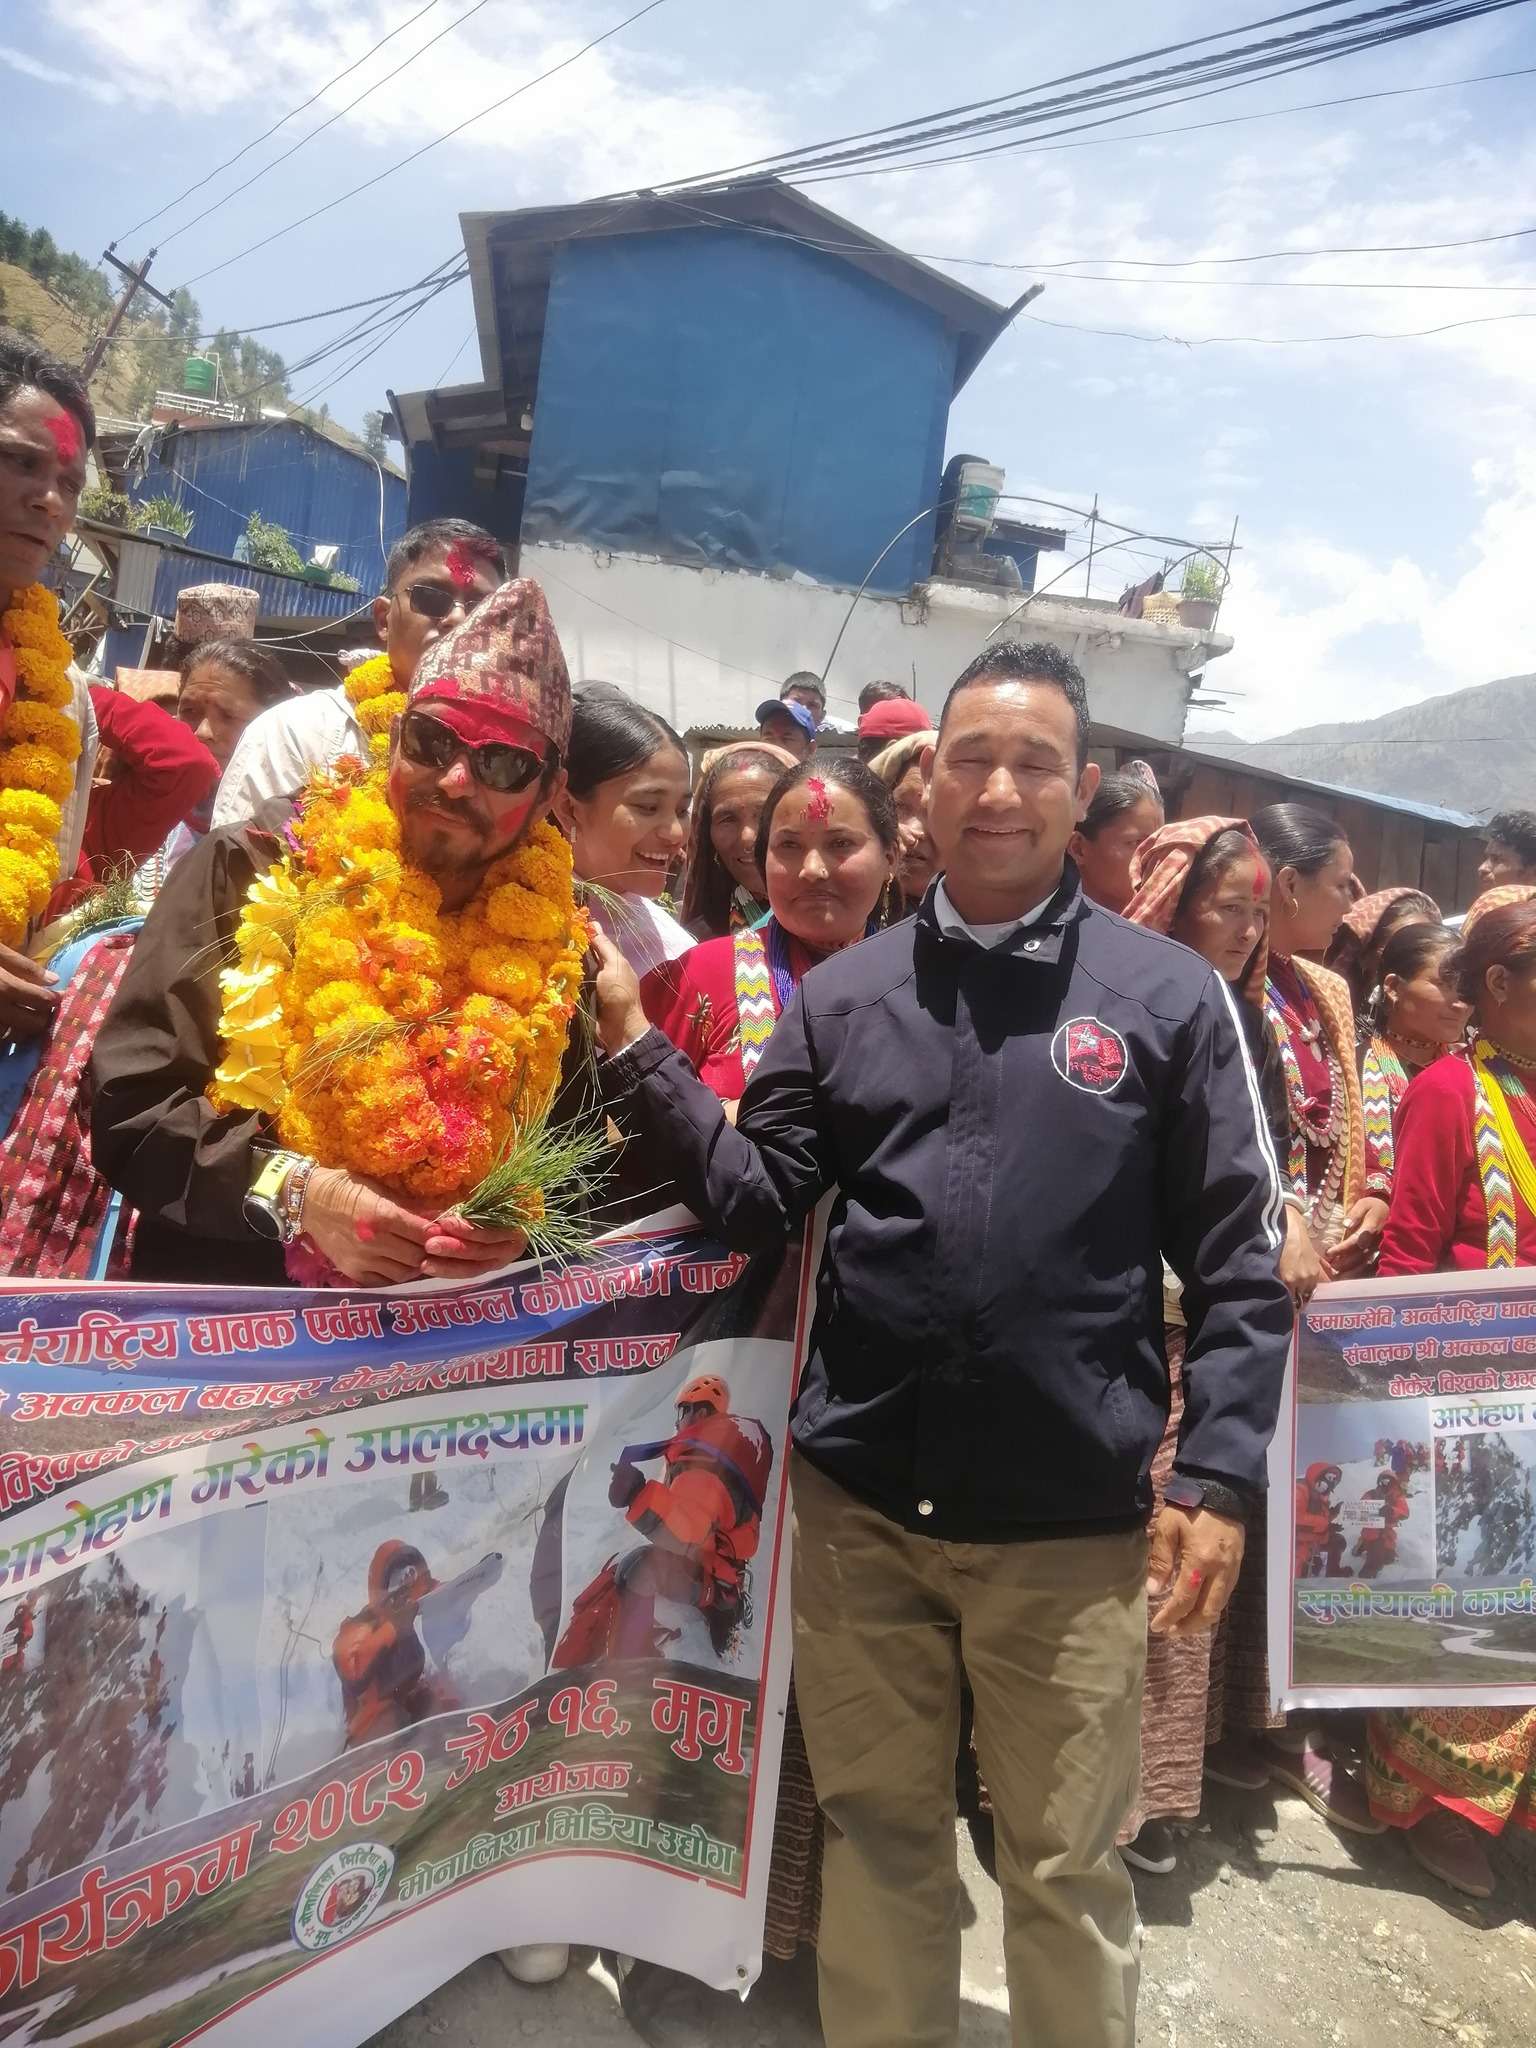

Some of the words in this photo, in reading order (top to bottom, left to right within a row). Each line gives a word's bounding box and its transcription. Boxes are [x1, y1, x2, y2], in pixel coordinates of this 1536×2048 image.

[188, 1310, 297, 1358] धावक
[387, 1287, 518, 1336] अक्कल
[574, 1333, 681, 1376] सफल
[1342, 1343, 1414, 1366] संचालक
[1415, 1337, 1440, 1360] श्री
[1442, 1337, 1510, 1357] अक्कल
[11, 1386, 197, 1422] अक्कल
[197, 1376, 333, 1411] बहादुर
[1438, 1367, 1500, 1393] विश्वको
[1432, 1399, 1525, 1429] आरोहण
[191, 1428, 334, 1504] गरेको
[1462, 1577, 1536, 1616] कार्य
[269, 1751, 427, 1853] २०८२
[445, 1699, 538, 1790] जेठ
[651, 1678, 750, 1775] मुगु
[494, 1761, 632, 1814] आयोजक
[545, 1803, 653, 1848] मिडिया
